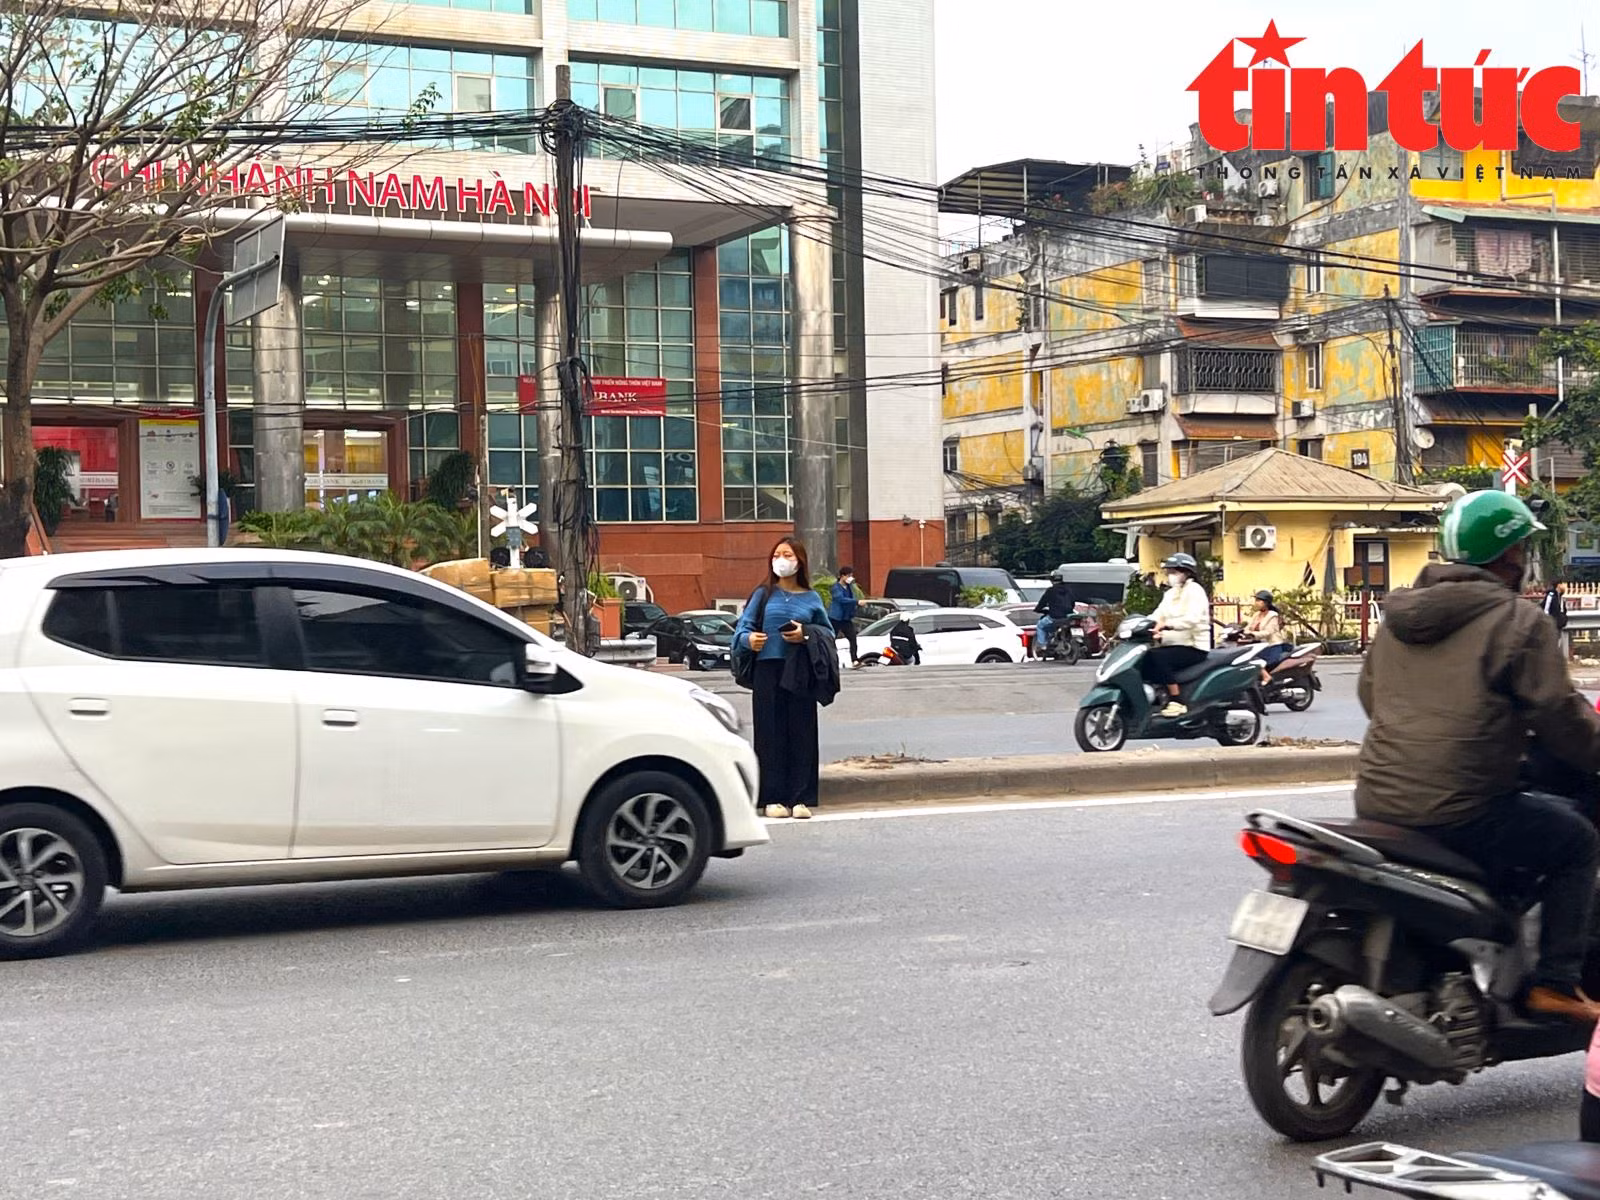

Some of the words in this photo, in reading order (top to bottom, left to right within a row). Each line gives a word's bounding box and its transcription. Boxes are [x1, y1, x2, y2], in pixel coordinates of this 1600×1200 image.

[90, 154, 165, 193] CHI
[347, 168, 447, 210] NAM
[457, 170, 516, 216] HÀ
[524, 181, 591, 219] NI
